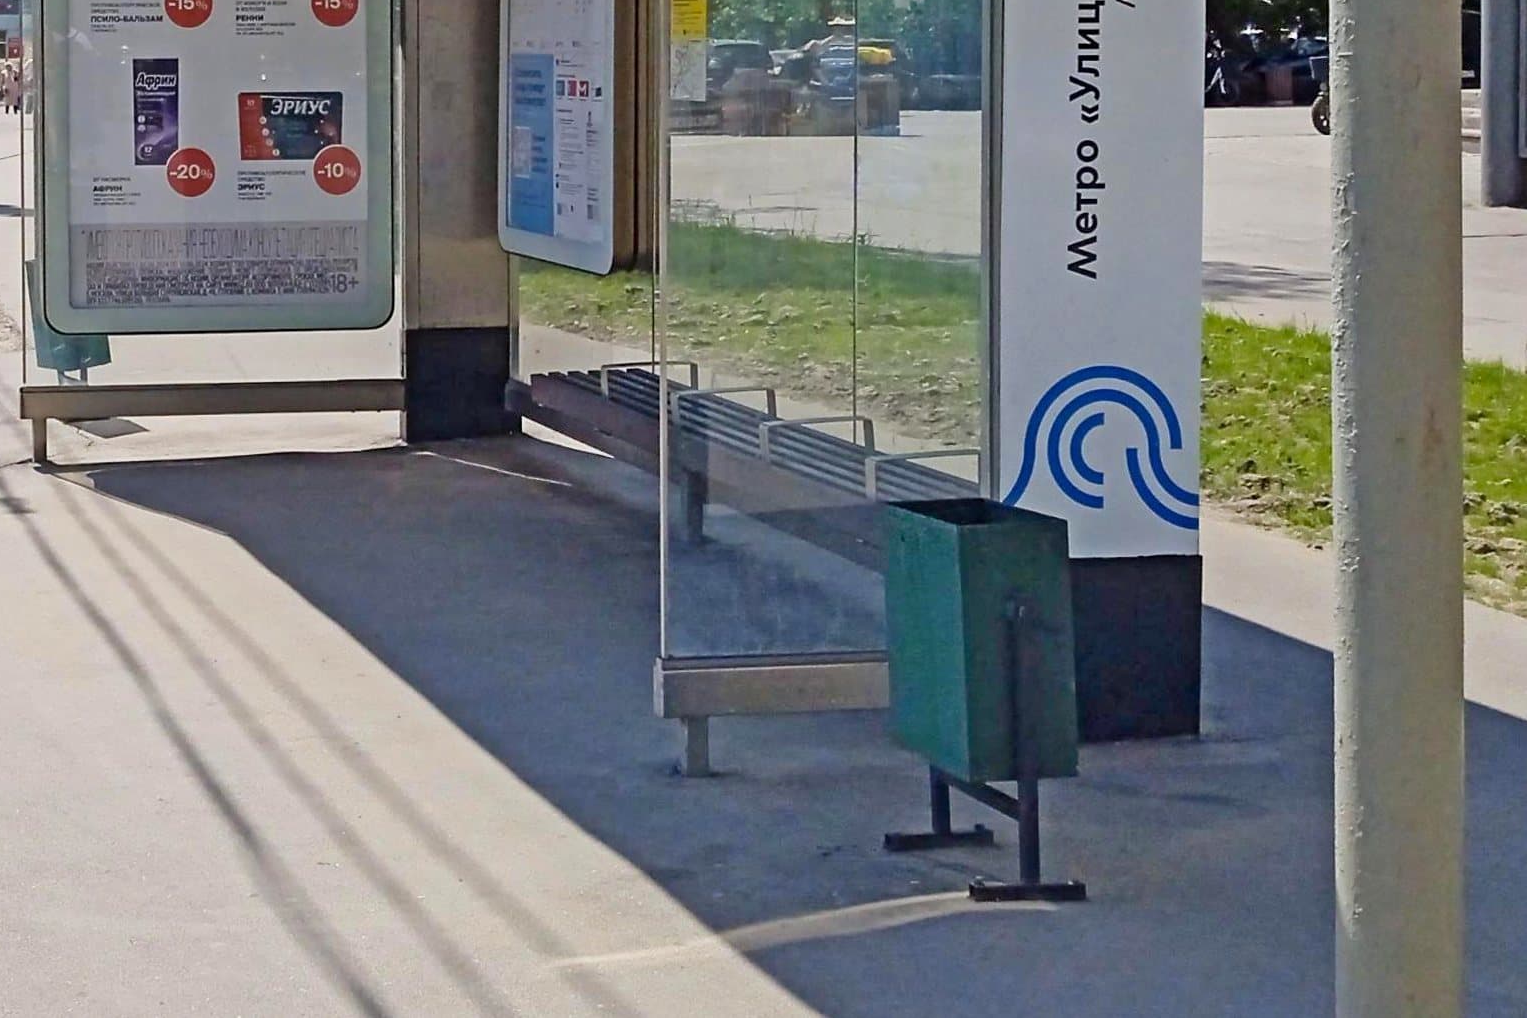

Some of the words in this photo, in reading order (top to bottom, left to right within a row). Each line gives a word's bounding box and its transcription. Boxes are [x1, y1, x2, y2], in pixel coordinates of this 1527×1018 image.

[90, 15, 164, 23] ПСИЛО-БАЛЬЗАМ
[135, 72, 177, 90] Африн
[270, 99, 331, 116] ЭРИУС
[169, 164, 213, 179] -20%
[1067, 139, 1105, 279] Метро
